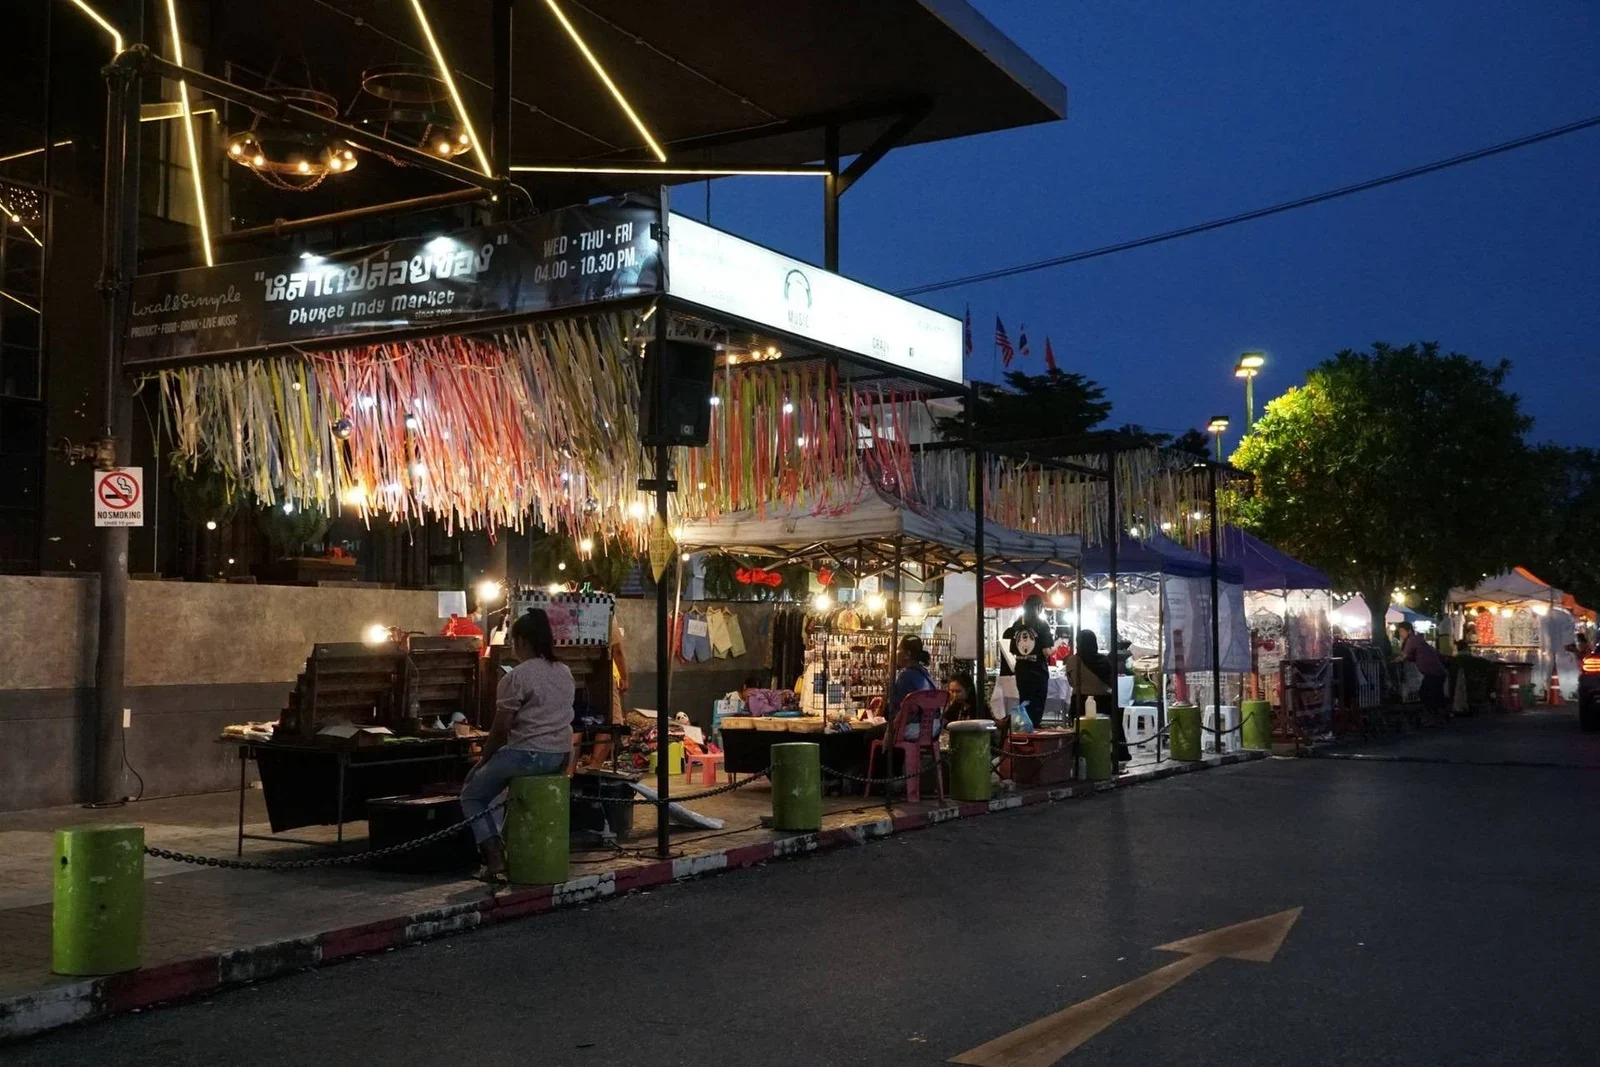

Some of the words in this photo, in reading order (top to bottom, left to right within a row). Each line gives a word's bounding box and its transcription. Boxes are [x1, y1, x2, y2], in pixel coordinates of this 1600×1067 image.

[543, 236, 568, 258] WED
[580, 229, 604, 251] THU
[615, 222, 633, 245] FRI
[533, 260, 567, 284] 04.00
[580, 252, 615, 276] 10.30
[289, 304, 345, 325] Phuket
[350, 299, 386, 317] Indy
[97, 511, 107, 519] NO
[108, 511, 141, 519] SMOKING
